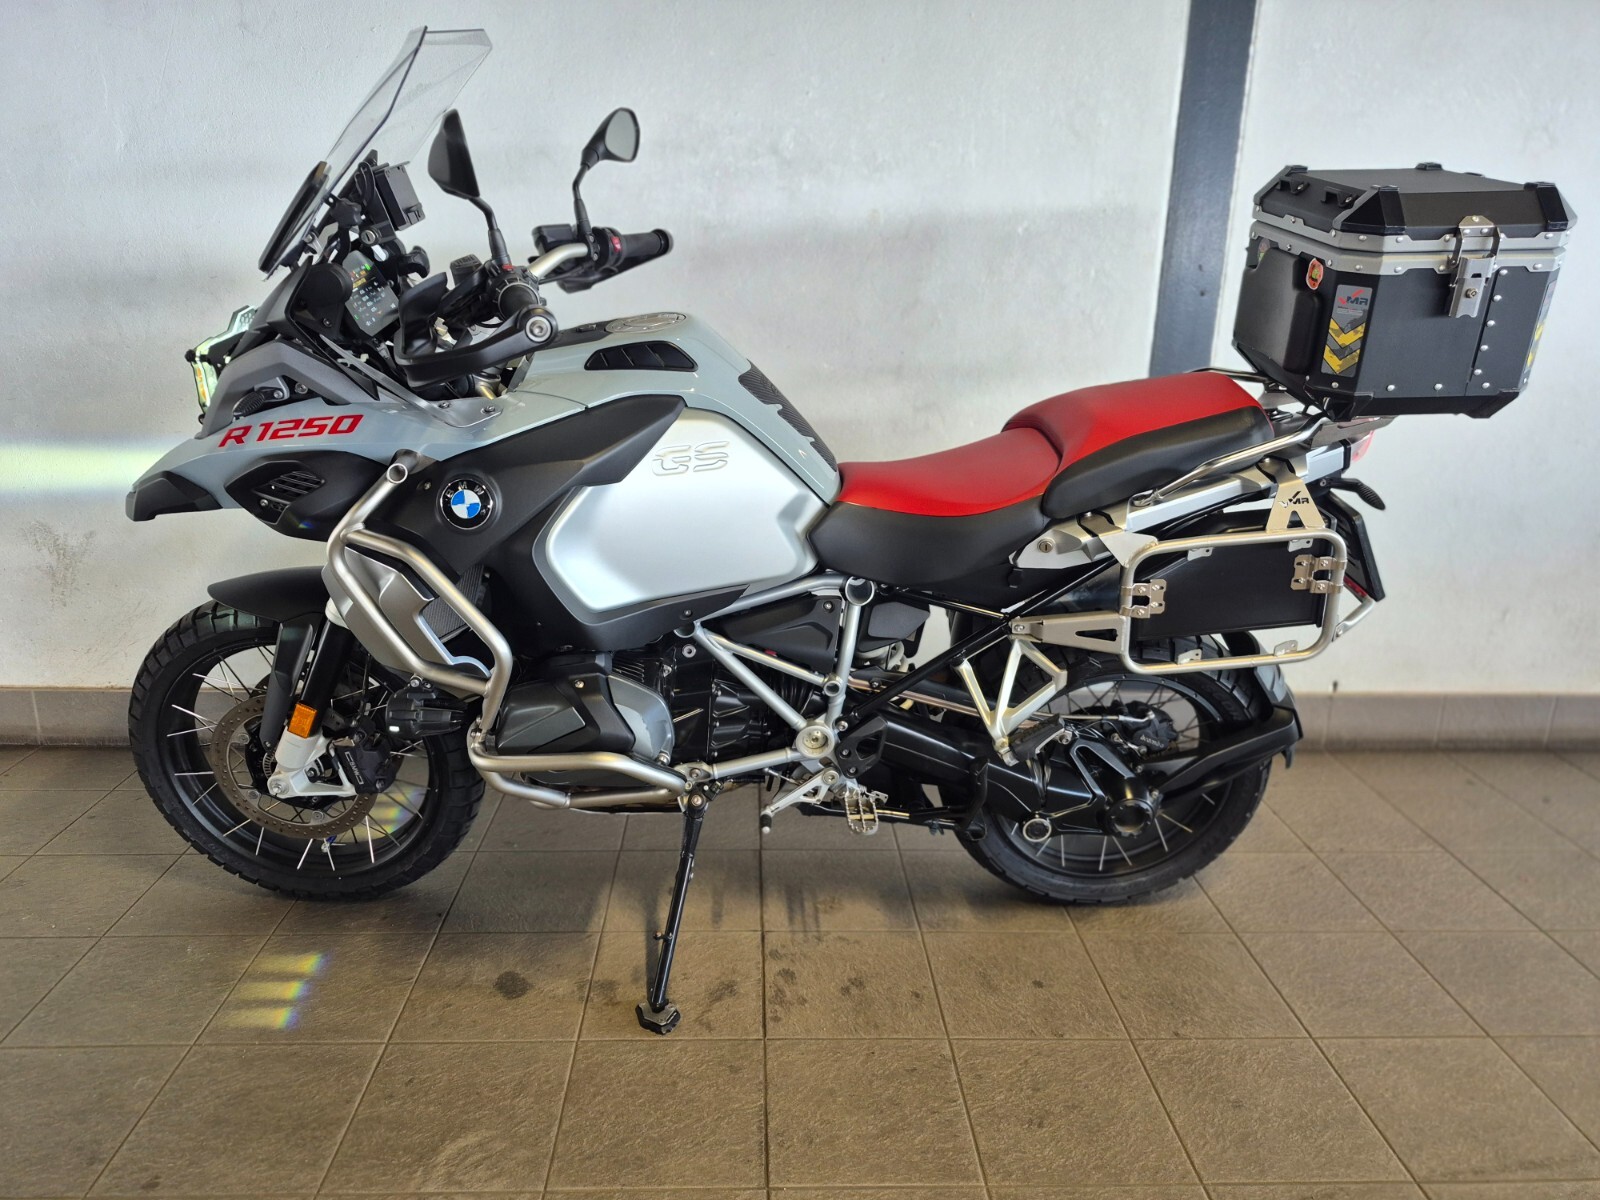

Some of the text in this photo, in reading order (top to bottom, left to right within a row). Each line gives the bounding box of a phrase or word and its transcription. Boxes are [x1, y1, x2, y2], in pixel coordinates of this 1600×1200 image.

[218, 414, 364, 448] R 1250
[652, 440, 729, 476] GS
[445, 481, 485, 498] BMW
